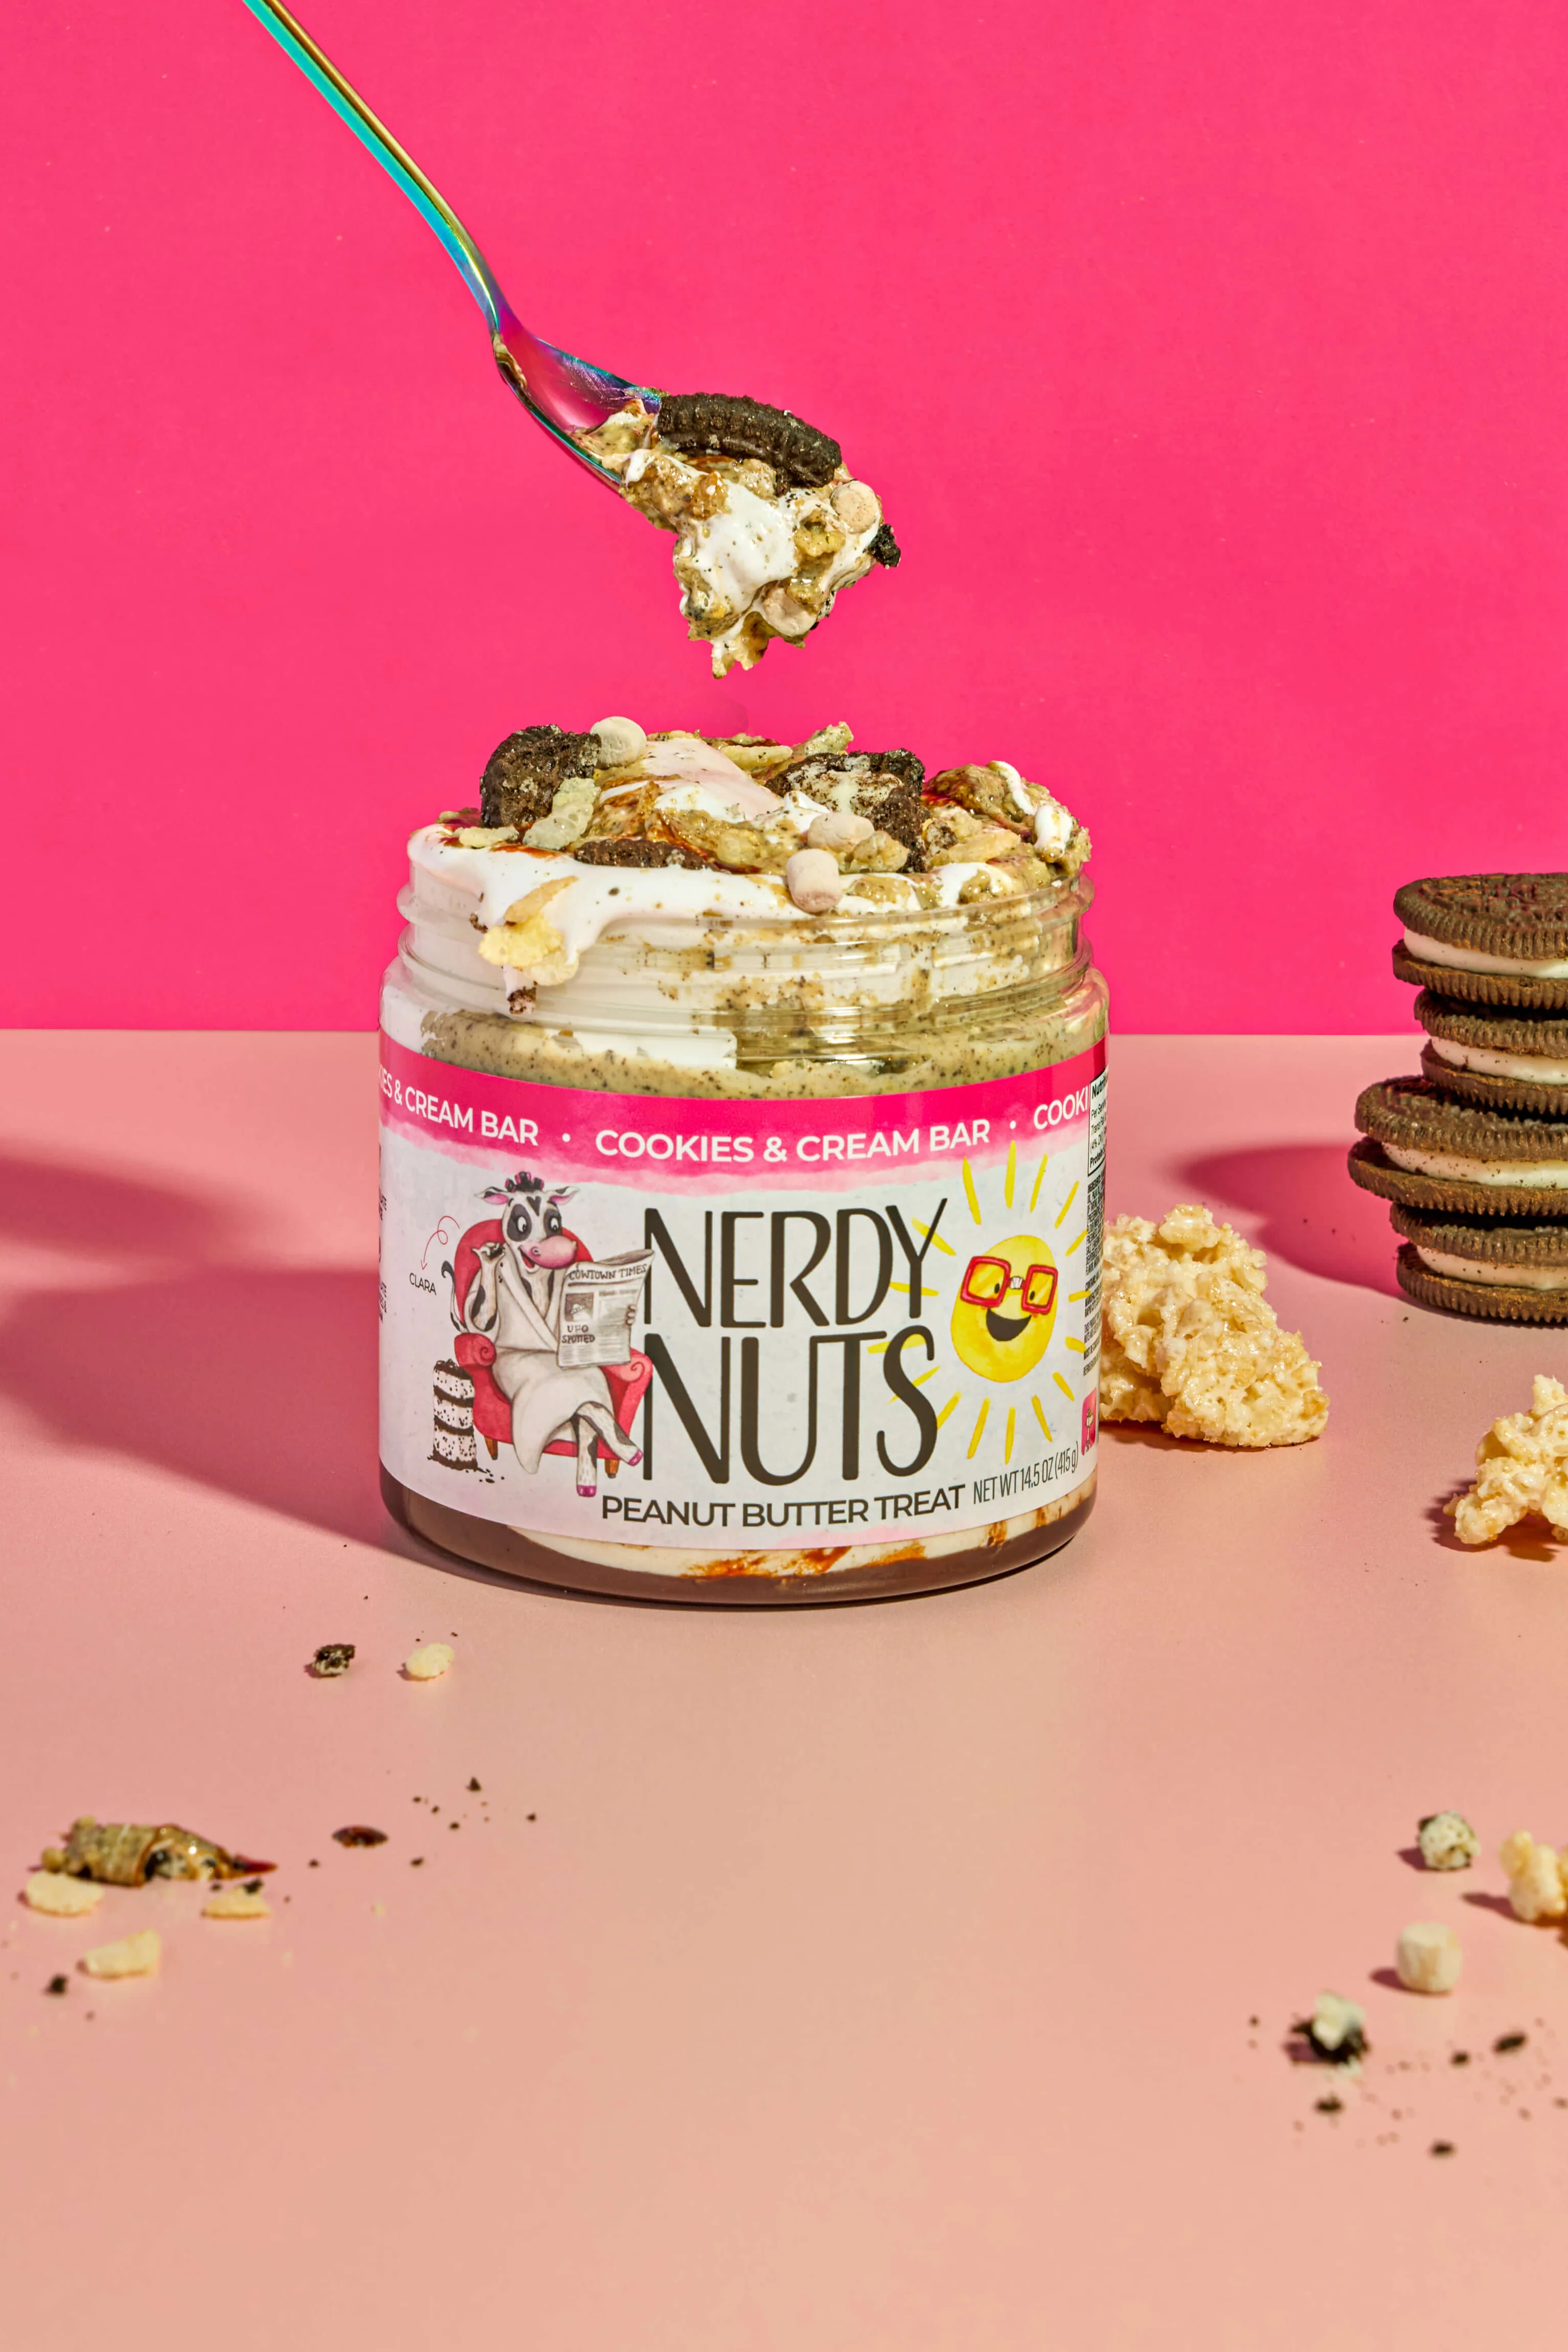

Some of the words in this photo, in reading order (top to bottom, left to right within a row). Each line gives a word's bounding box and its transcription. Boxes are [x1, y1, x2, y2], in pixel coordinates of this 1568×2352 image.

[395, 1080, 402, 1105] &
[405, 1087, 473, 1132] CREAM
[482, 1111, 538, 1145] BAR
[596, 1130, 754, 1162] COOKIES
[764, 1136, 787, 1162] &
[797, 1129, 919, 1160] CREAM
[929, 1119, 990, 1152] BAR
[410, 1273, 436, 1295] CLARA
[569, 1270, 616, 1280] COWTOWN
[619, 1264, 647, 1278] TIMES
[644, 1198, 948, 1328] NERDY
[561, 1334, 595, 1344] SPOTTED
[567, 1325, 589, 1333] UFO
[643, 1325, 938, 1486] NUTS
[973, 1476, 998, 1504] NET
[999, 1470, 1019, 1497] WT
[1021, 1463, 1039, 1491] 14.5
[1042, 1457, 1054, 1483] OZ
[603, 1496, 736, 1526] PEANUT
[743, 1499, 868, 1526] BUTTER
[874, 1483, 965, 1520] TREAT
